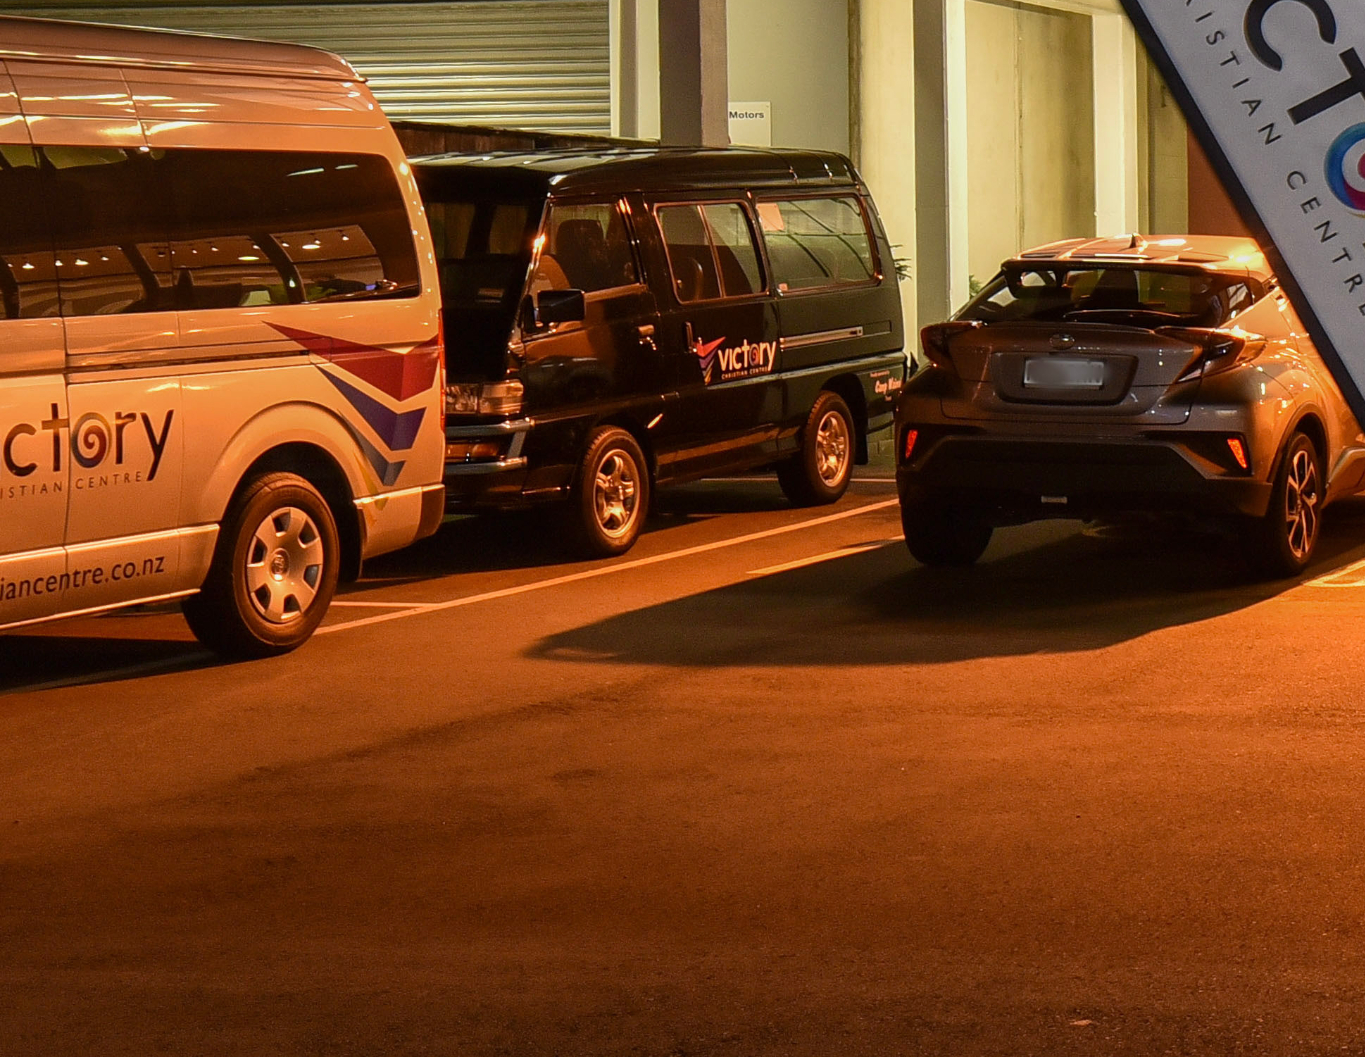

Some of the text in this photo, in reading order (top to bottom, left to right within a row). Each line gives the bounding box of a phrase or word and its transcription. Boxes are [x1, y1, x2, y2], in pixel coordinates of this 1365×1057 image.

[728, 111, 765, 119] Motors
[721, 370, 748, 380] CHRISTIAN
[75, 471, 142, 490] CENTRE
